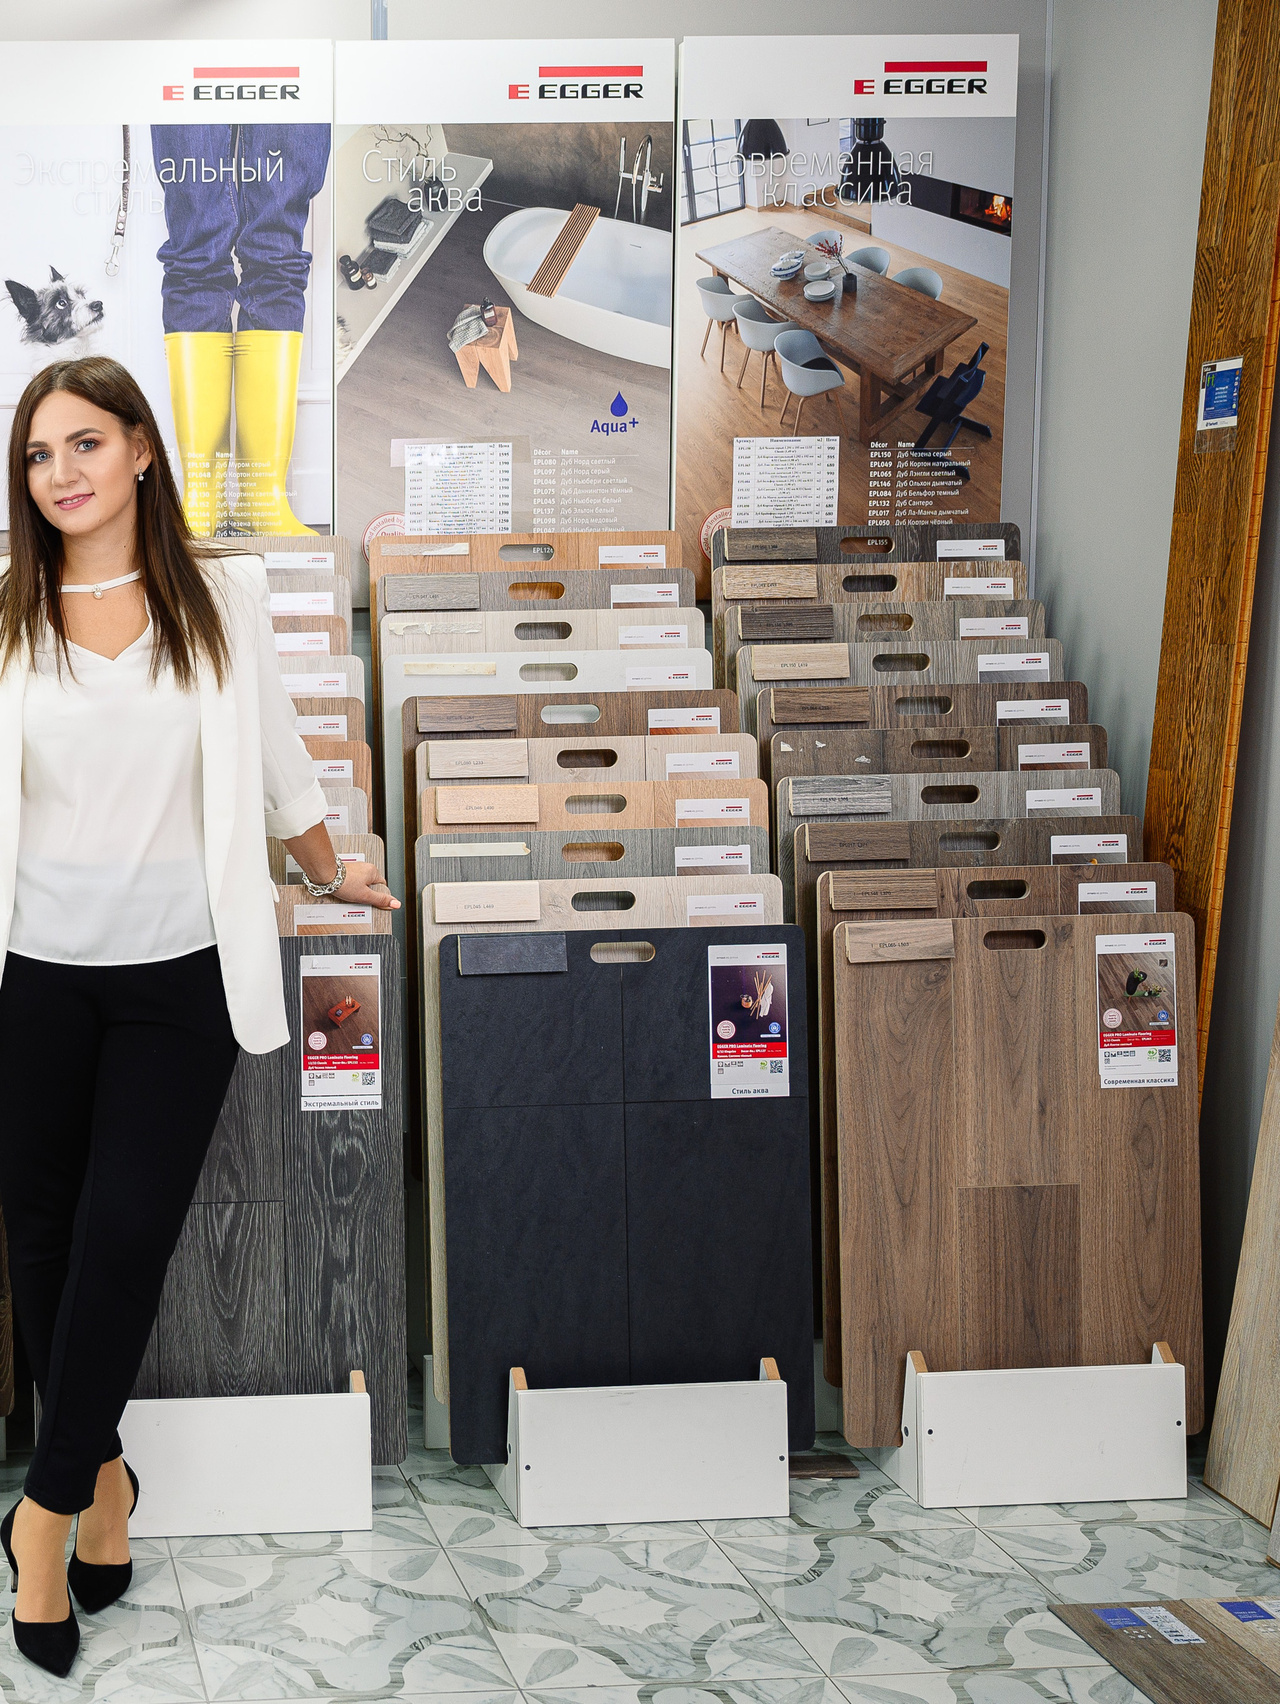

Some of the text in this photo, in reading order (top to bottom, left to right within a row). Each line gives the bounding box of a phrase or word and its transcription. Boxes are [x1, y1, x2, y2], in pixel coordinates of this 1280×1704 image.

[193, 84, 300, 101] EGGER
[538, 83, 644, 99] EGGER
[883, 78, 988, 95] EGGER
[14, 150, 284, 189] Экстремальный
[361, 148, 456, 184] Стиль
[708, 144, 934, 180] Современная
[407, 184, 484, 212] аква
[762, 176, 913, 208] классика
[71, 186, 165, 216] стиль
[591, 417, 639, 436] Aqua+
[561, 458, 572, 466] Дуб
[897, 460, 908, 468] Дуб
[561, 478, 572, 486] Дуб
[896, 470, 908, 478] Дуб
[896, 480, 908, 488] Дуб
[931, 479, 962, 487] дымчатый
[896, 490, 907, 498] Дуб
[1103, 1077, 1146, 1086] Современная
[731, 1087, 751, 1095] Стиль
[303, 1100, 359, 1108] Экстремальный
